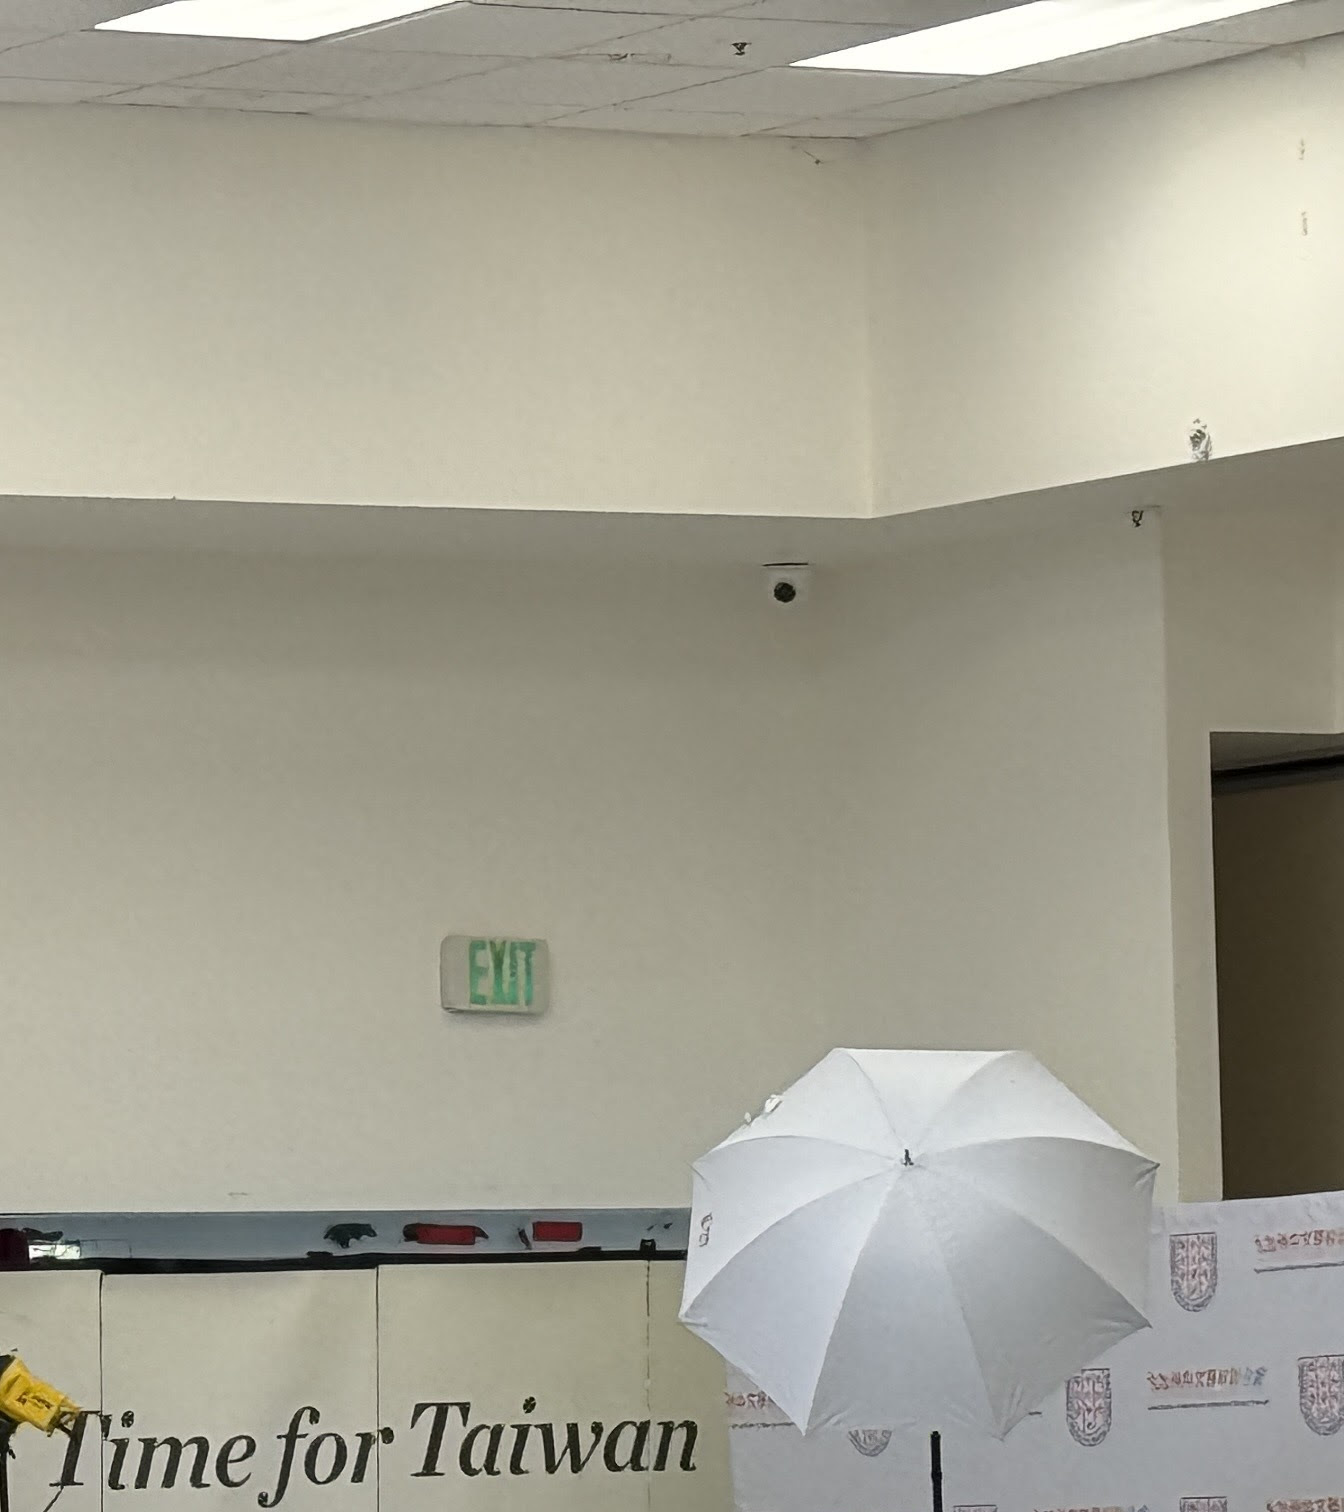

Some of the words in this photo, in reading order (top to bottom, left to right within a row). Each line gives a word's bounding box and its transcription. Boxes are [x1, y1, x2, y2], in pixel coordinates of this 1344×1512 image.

[468, 939, 536, 1007] EXIT
[48, 1410, 257, 1490] Time
[258, 1406, 395, 1509] for
[410, 1396, 698, 1478] Taiwan
